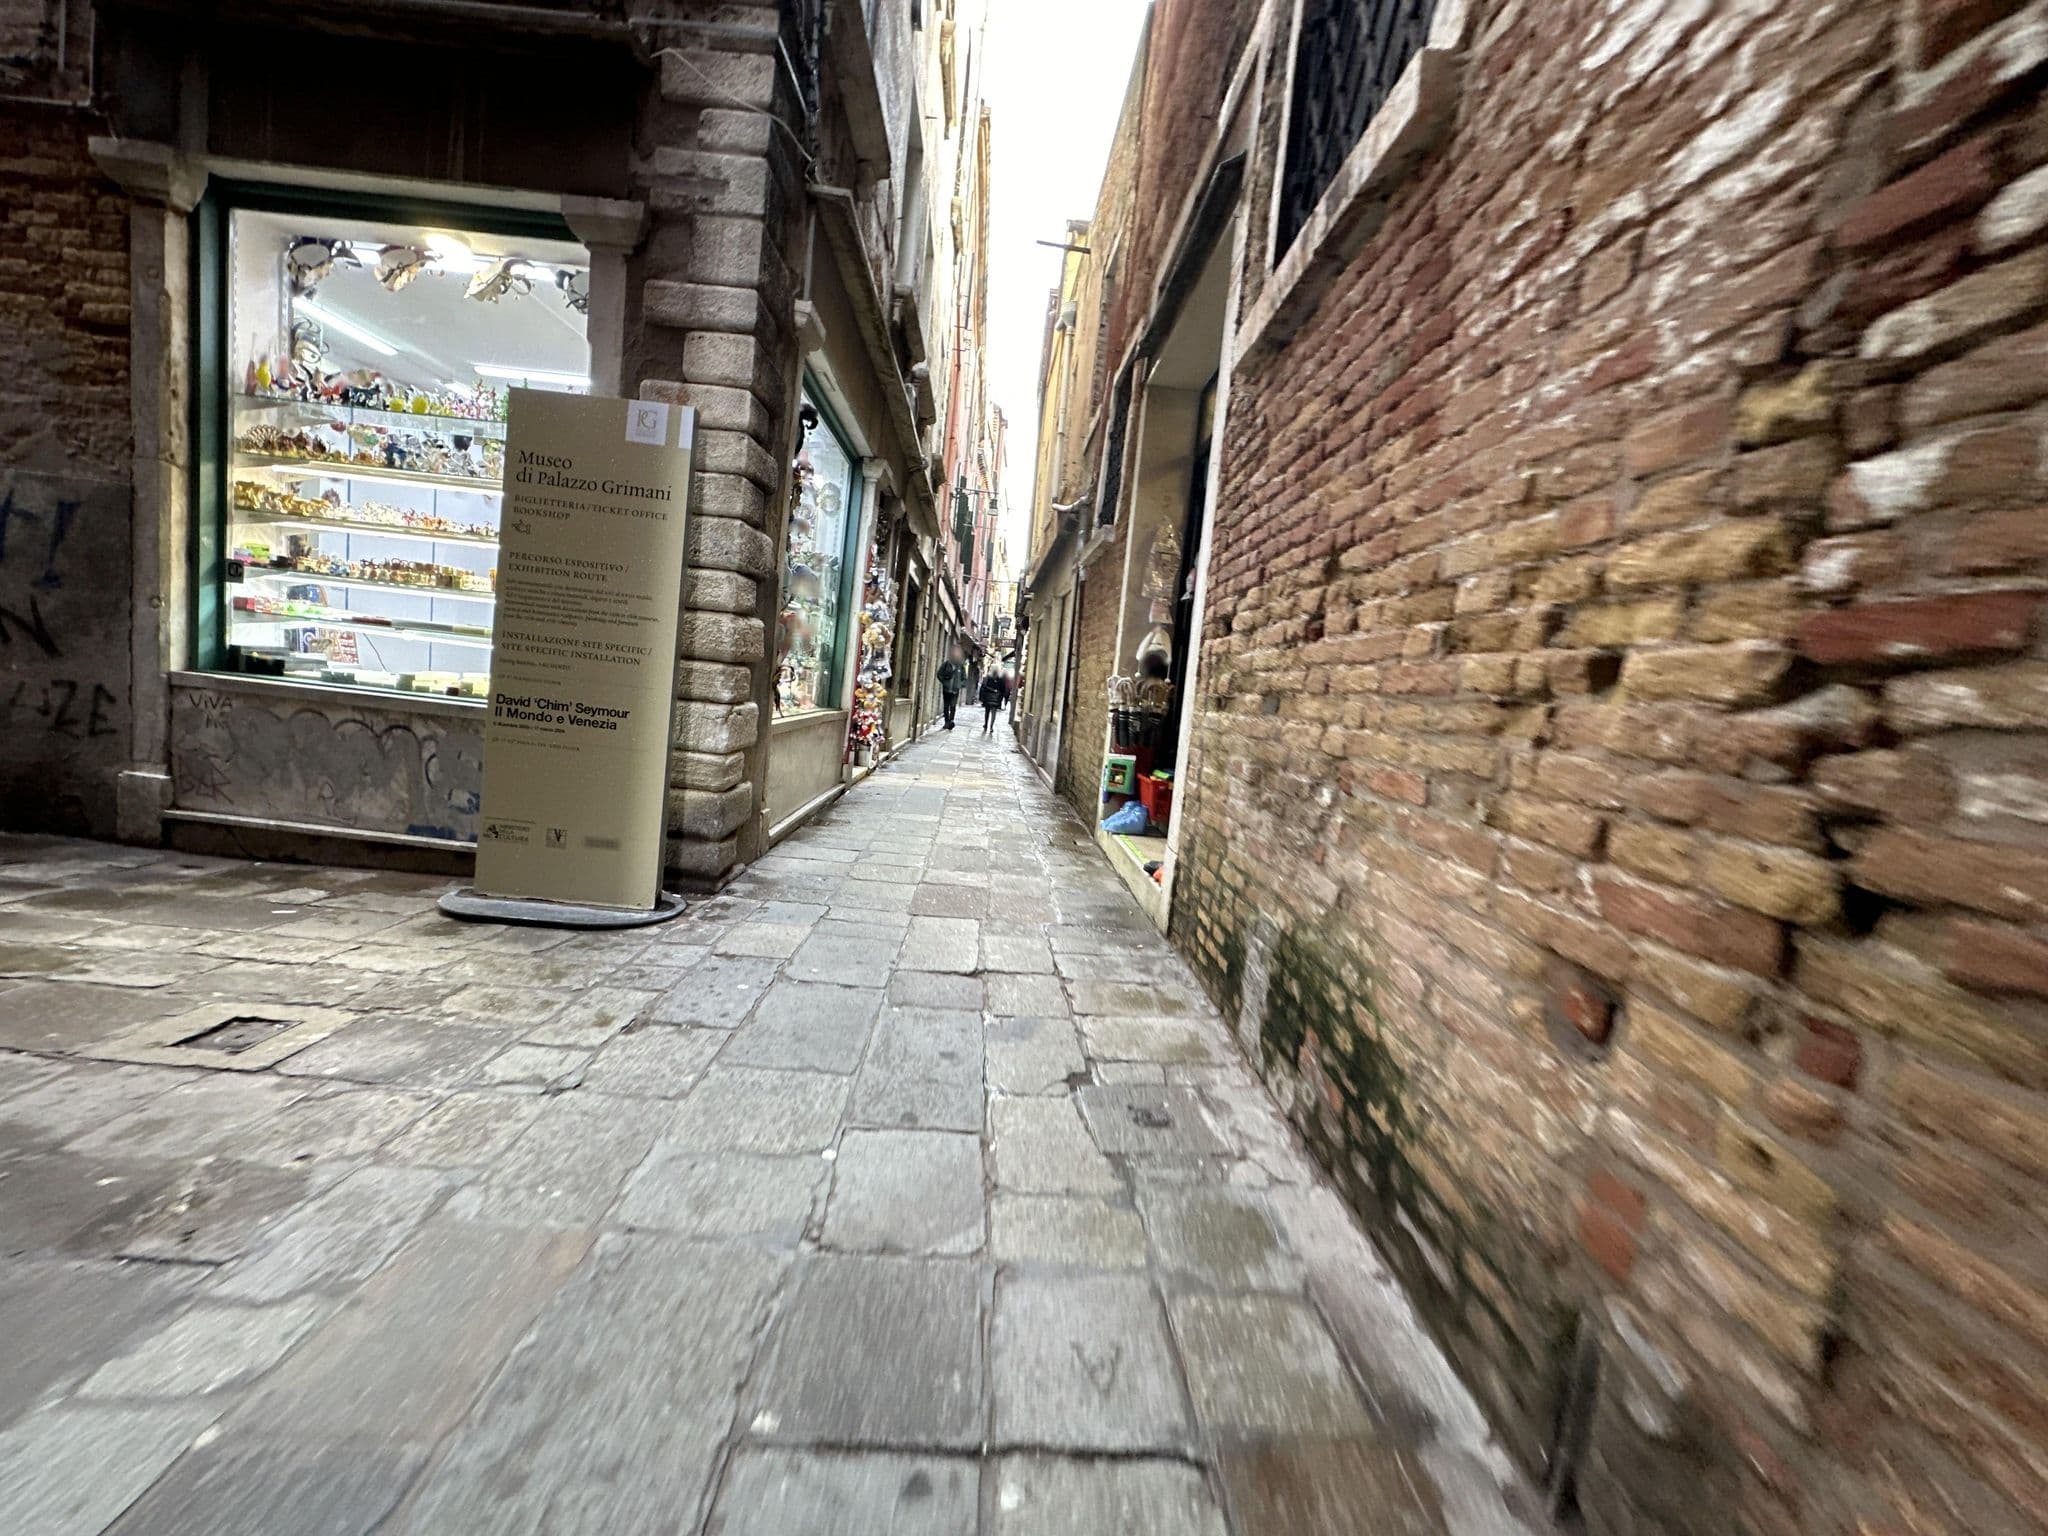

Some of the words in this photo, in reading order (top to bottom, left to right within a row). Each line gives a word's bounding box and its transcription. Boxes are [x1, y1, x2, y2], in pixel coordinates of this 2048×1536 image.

[519, 450, 572, 469] Museo
[516, 466, 533, 484] di
[538, 470, 598, 492] Palazzo
[601, 479, 672, 501] Grimani
[514, 505, 570, 520] BOOKSHOP
[631, 508, 668, 521] OFFICE
[508, 562, 570, 578] EXHIBITION
[573, 570, 608, 582] ROUTE
[509, 551, 562, 564] PERCORSO
[565, 557, 624, 573] ESPOSITIVO
[500, 642, 521, 652] SITE
[524, 645, 567, 658] SPECIFIC
[570, 650, 641, 666] INSTALLATION
[502, 630, 579, 647] INSTALLAZIONE
[582, 639, 602, 651] SITE
[605, 642, 648, 656] SPECIFIC
[495, 693, 531, 708] David
[575, 702, 631, 719] Seymour
[495, 706, 502, 717] Il
[506, 707, 553, 723] Mondo
[556, 715, 565, 724] e
[568, 714, 617, 730] Venezia
